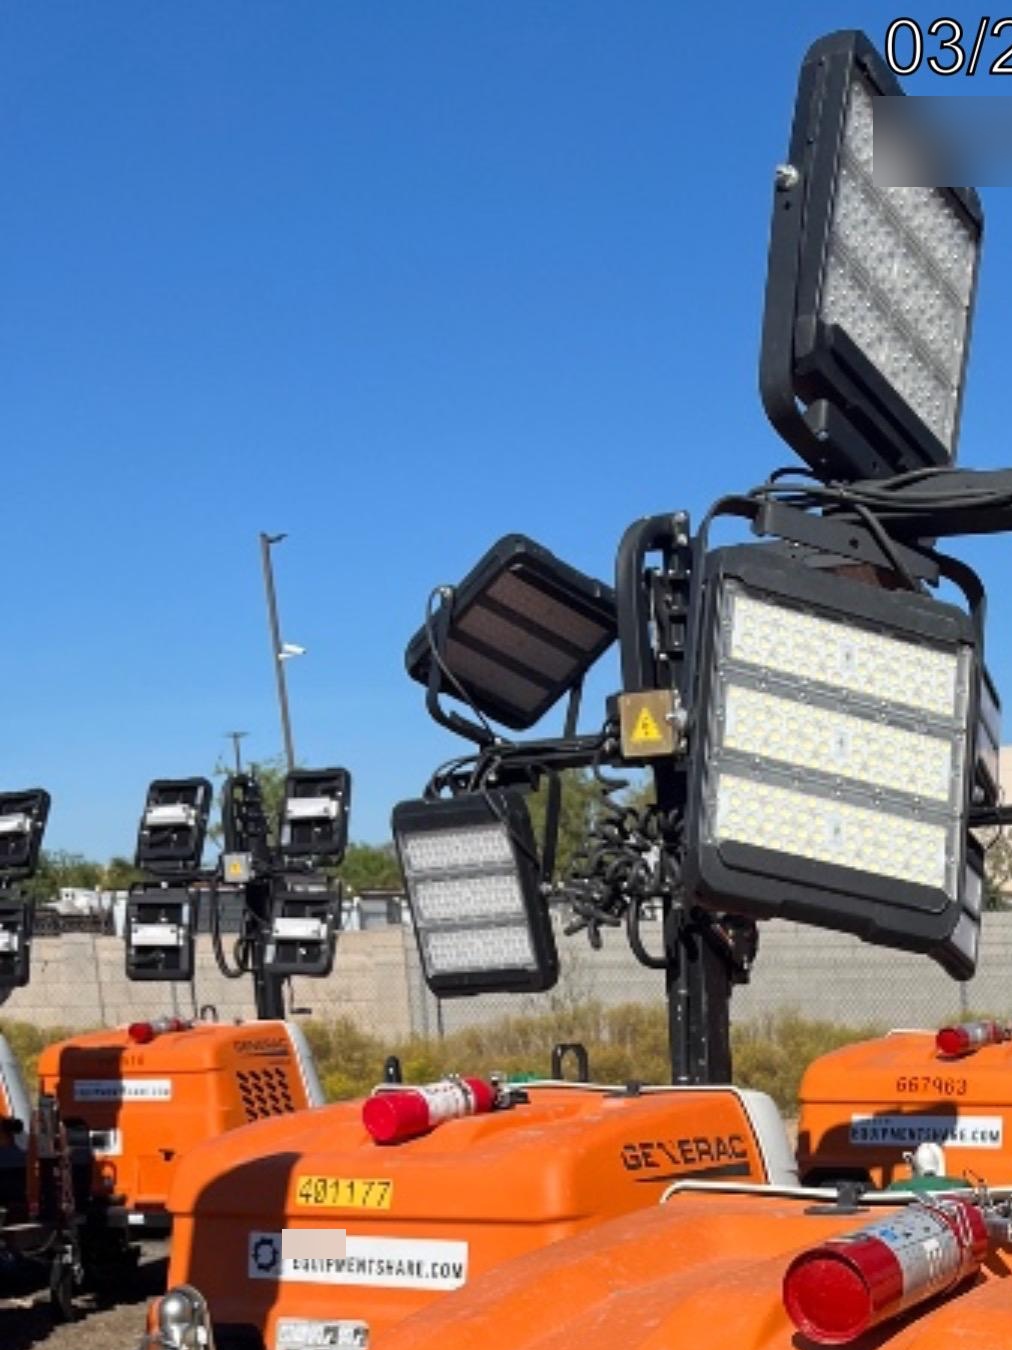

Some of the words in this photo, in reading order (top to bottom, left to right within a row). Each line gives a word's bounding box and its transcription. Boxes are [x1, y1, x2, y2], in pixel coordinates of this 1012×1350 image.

[896, 1076, 968, 1096] 667963
[621, 1134, 748, 1171] GENERAC
[299, 1178, 391, 1206] 401177
